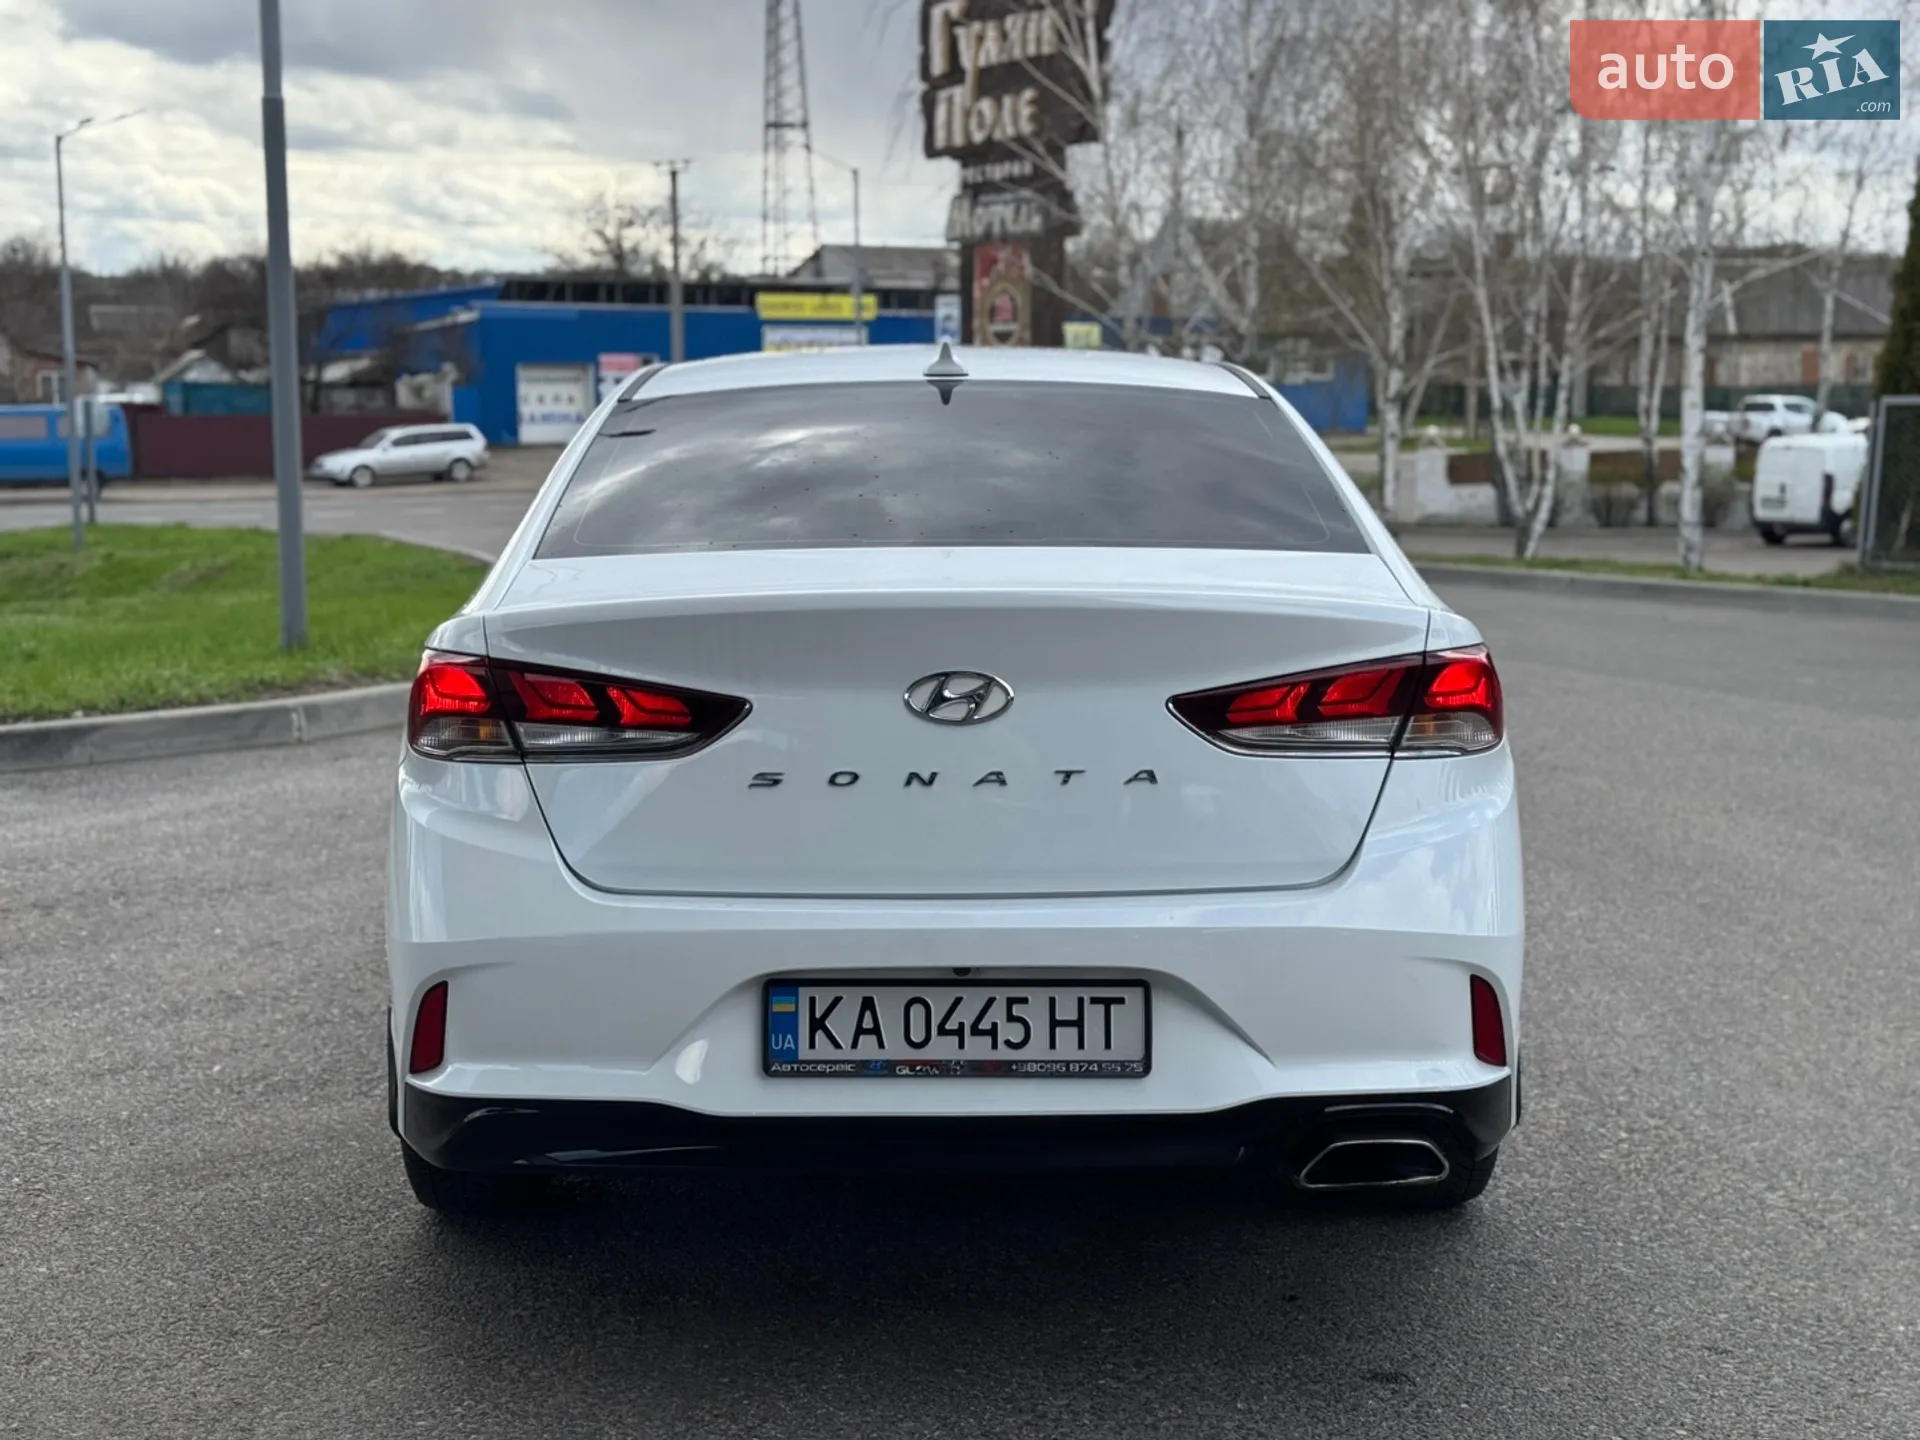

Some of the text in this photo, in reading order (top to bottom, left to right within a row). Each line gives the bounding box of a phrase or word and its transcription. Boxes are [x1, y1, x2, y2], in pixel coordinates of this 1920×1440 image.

[747, 768, 1160, 789] SONATA
[902, 995, 1034, 1051] 0445
[771, 1033, 796, 1051] UA
